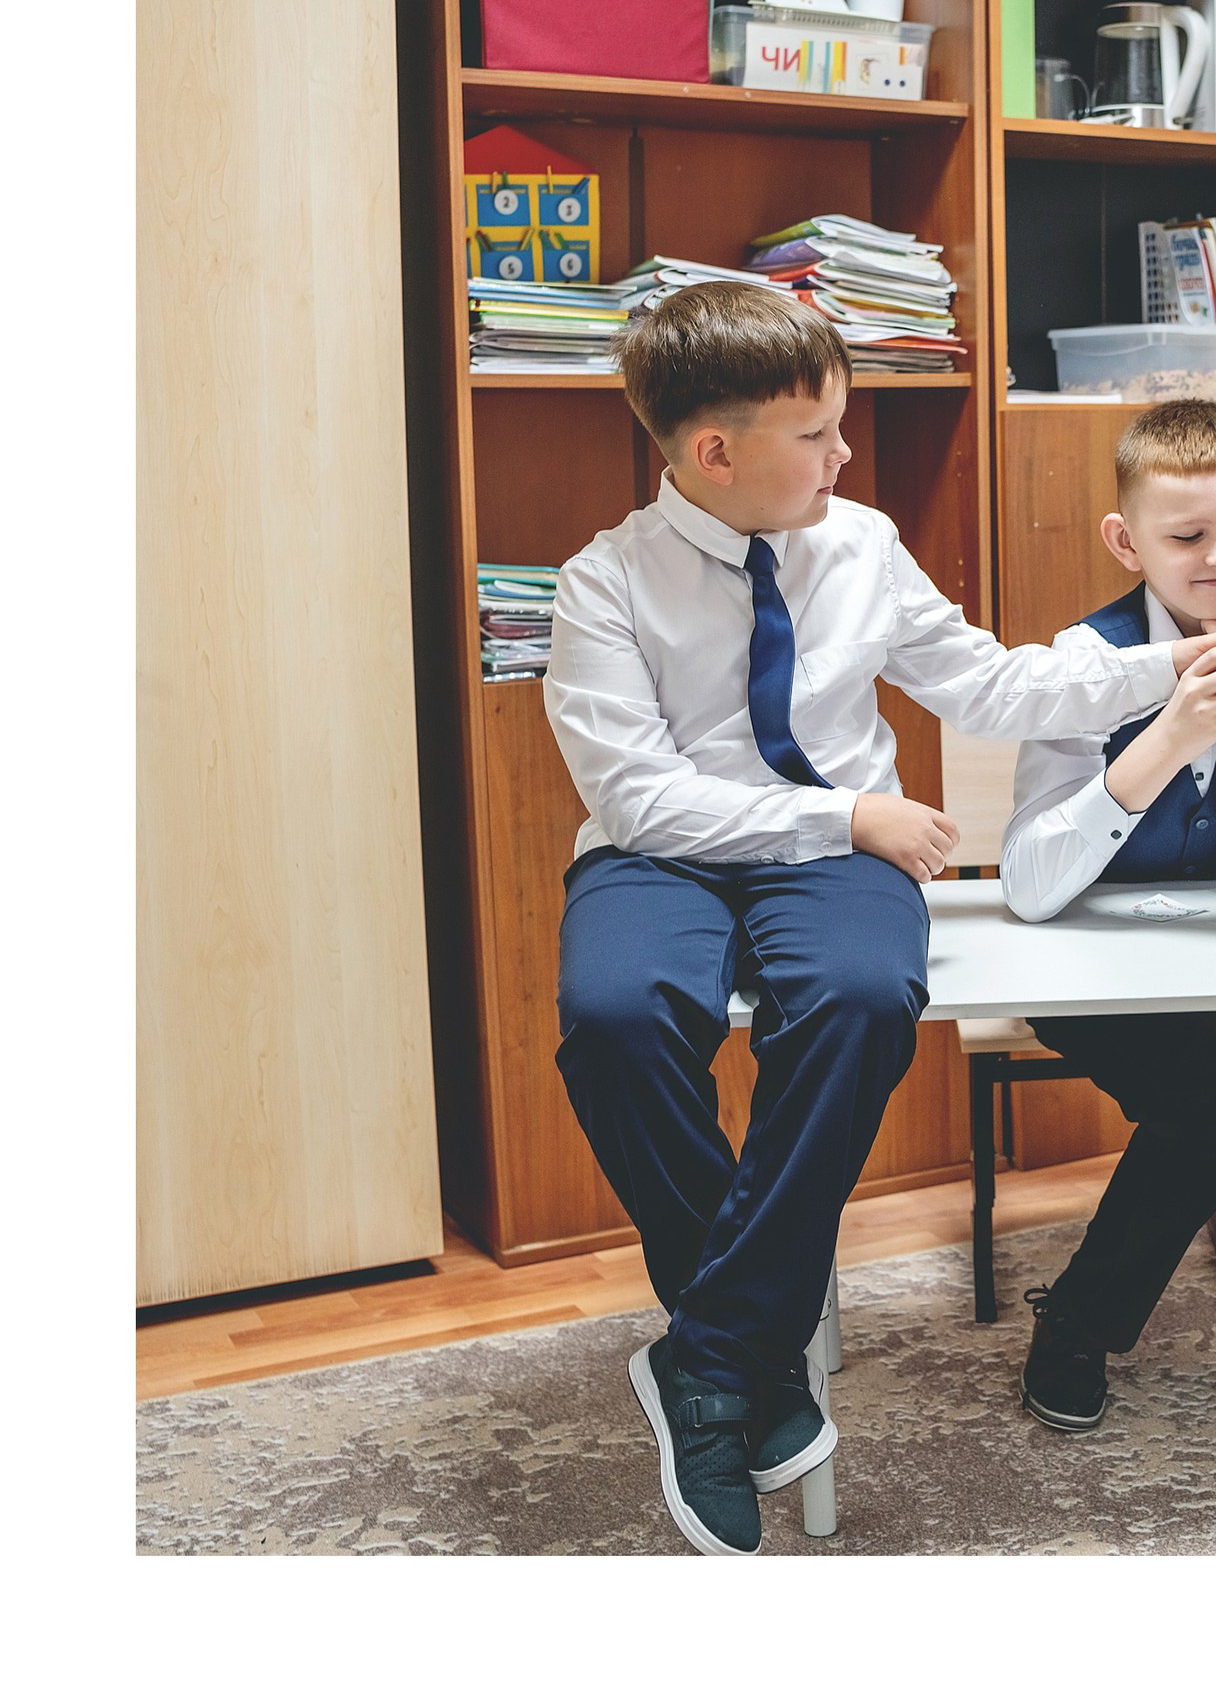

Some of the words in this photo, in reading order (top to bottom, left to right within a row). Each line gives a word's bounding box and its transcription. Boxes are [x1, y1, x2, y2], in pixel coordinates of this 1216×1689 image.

[503, 196, 510, 209] 2
[566, 204, 573, 216] 3
[508, 262, 515, 274] 5
[567, 259, 574, 271] 6
